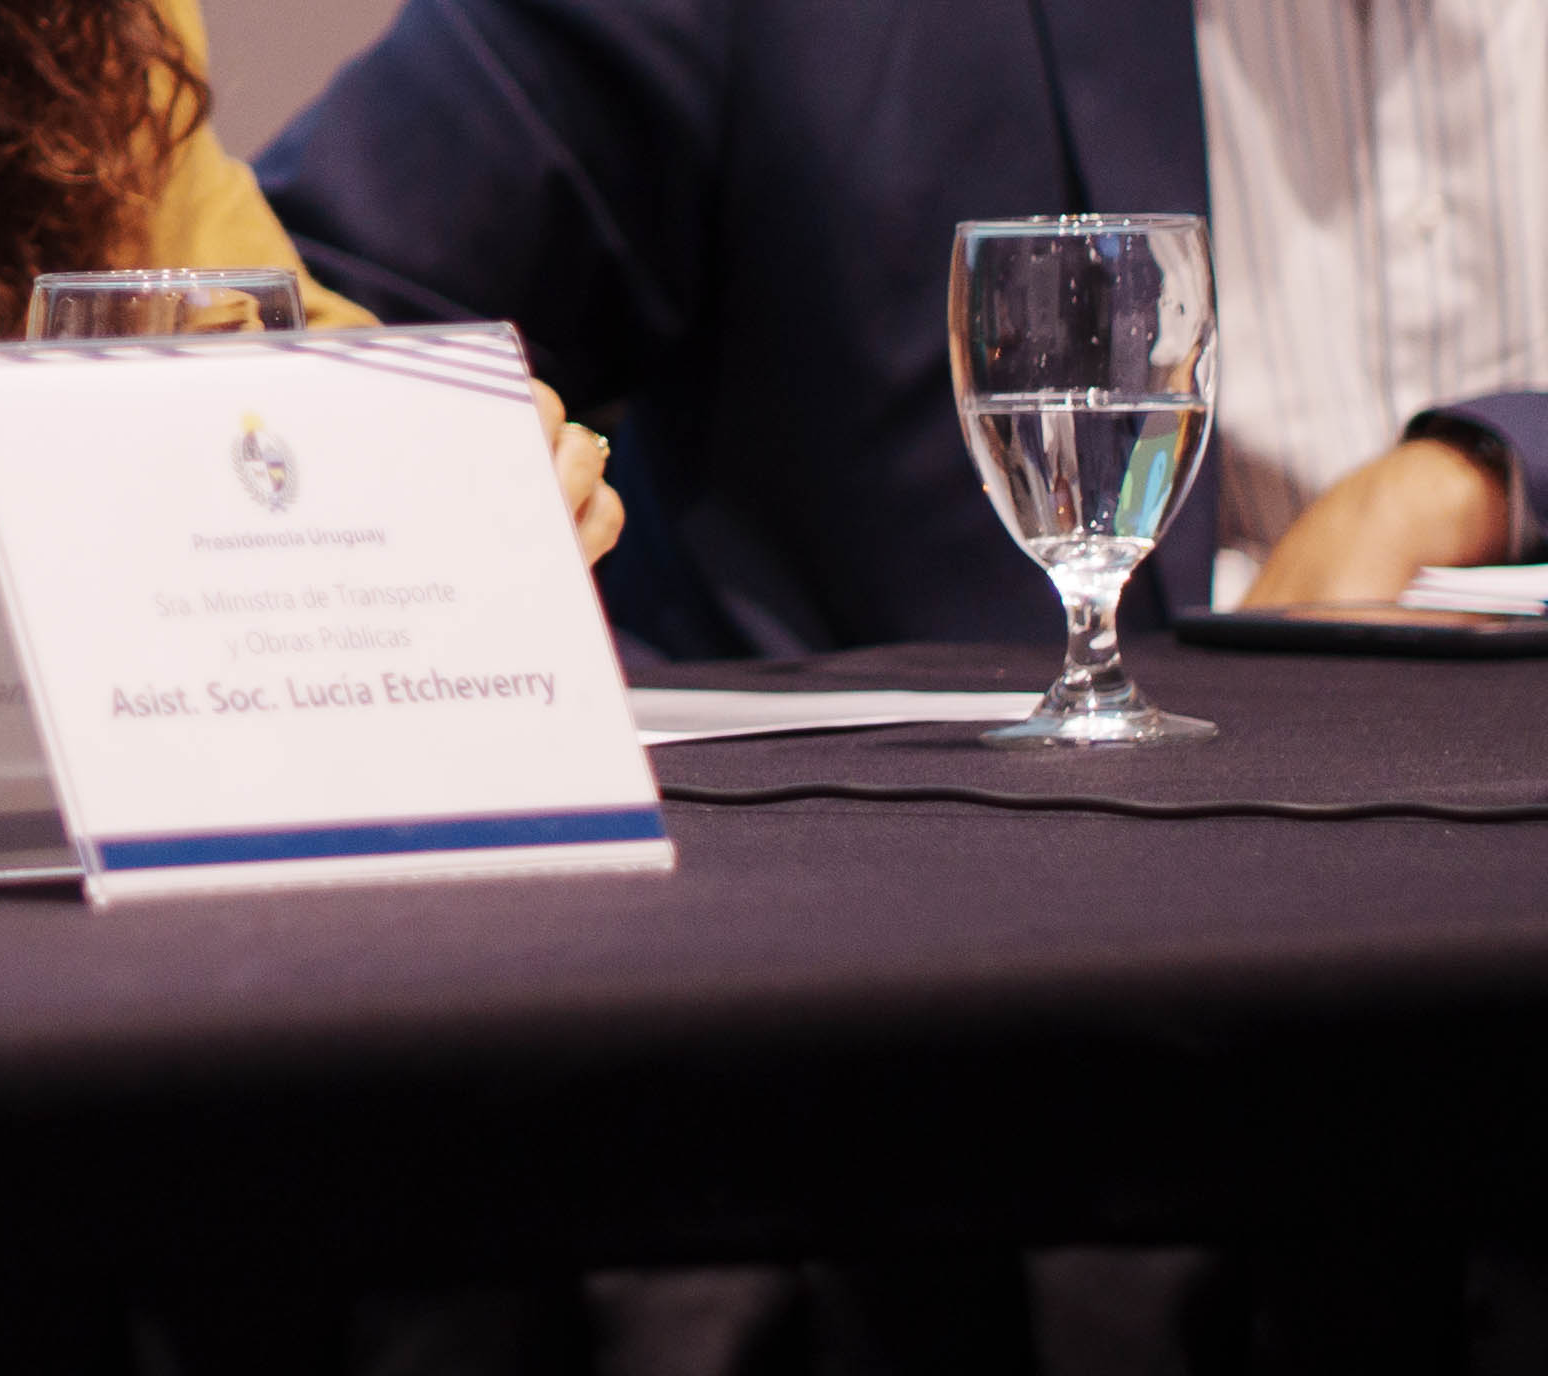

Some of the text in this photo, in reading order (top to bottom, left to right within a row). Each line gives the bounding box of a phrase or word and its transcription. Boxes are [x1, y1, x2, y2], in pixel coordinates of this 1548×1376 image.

[309, 527, 387, 550] Uruguay
[202, 587, 297, 613] Ministra
[303, 584, 330, 609] de
[333, 580, 456, 610] Transporte
[224, 622, 412, 659] y Obras Públicas
[111, 665, 556, 719] Asist. Soc. Lucía Etcheverry
